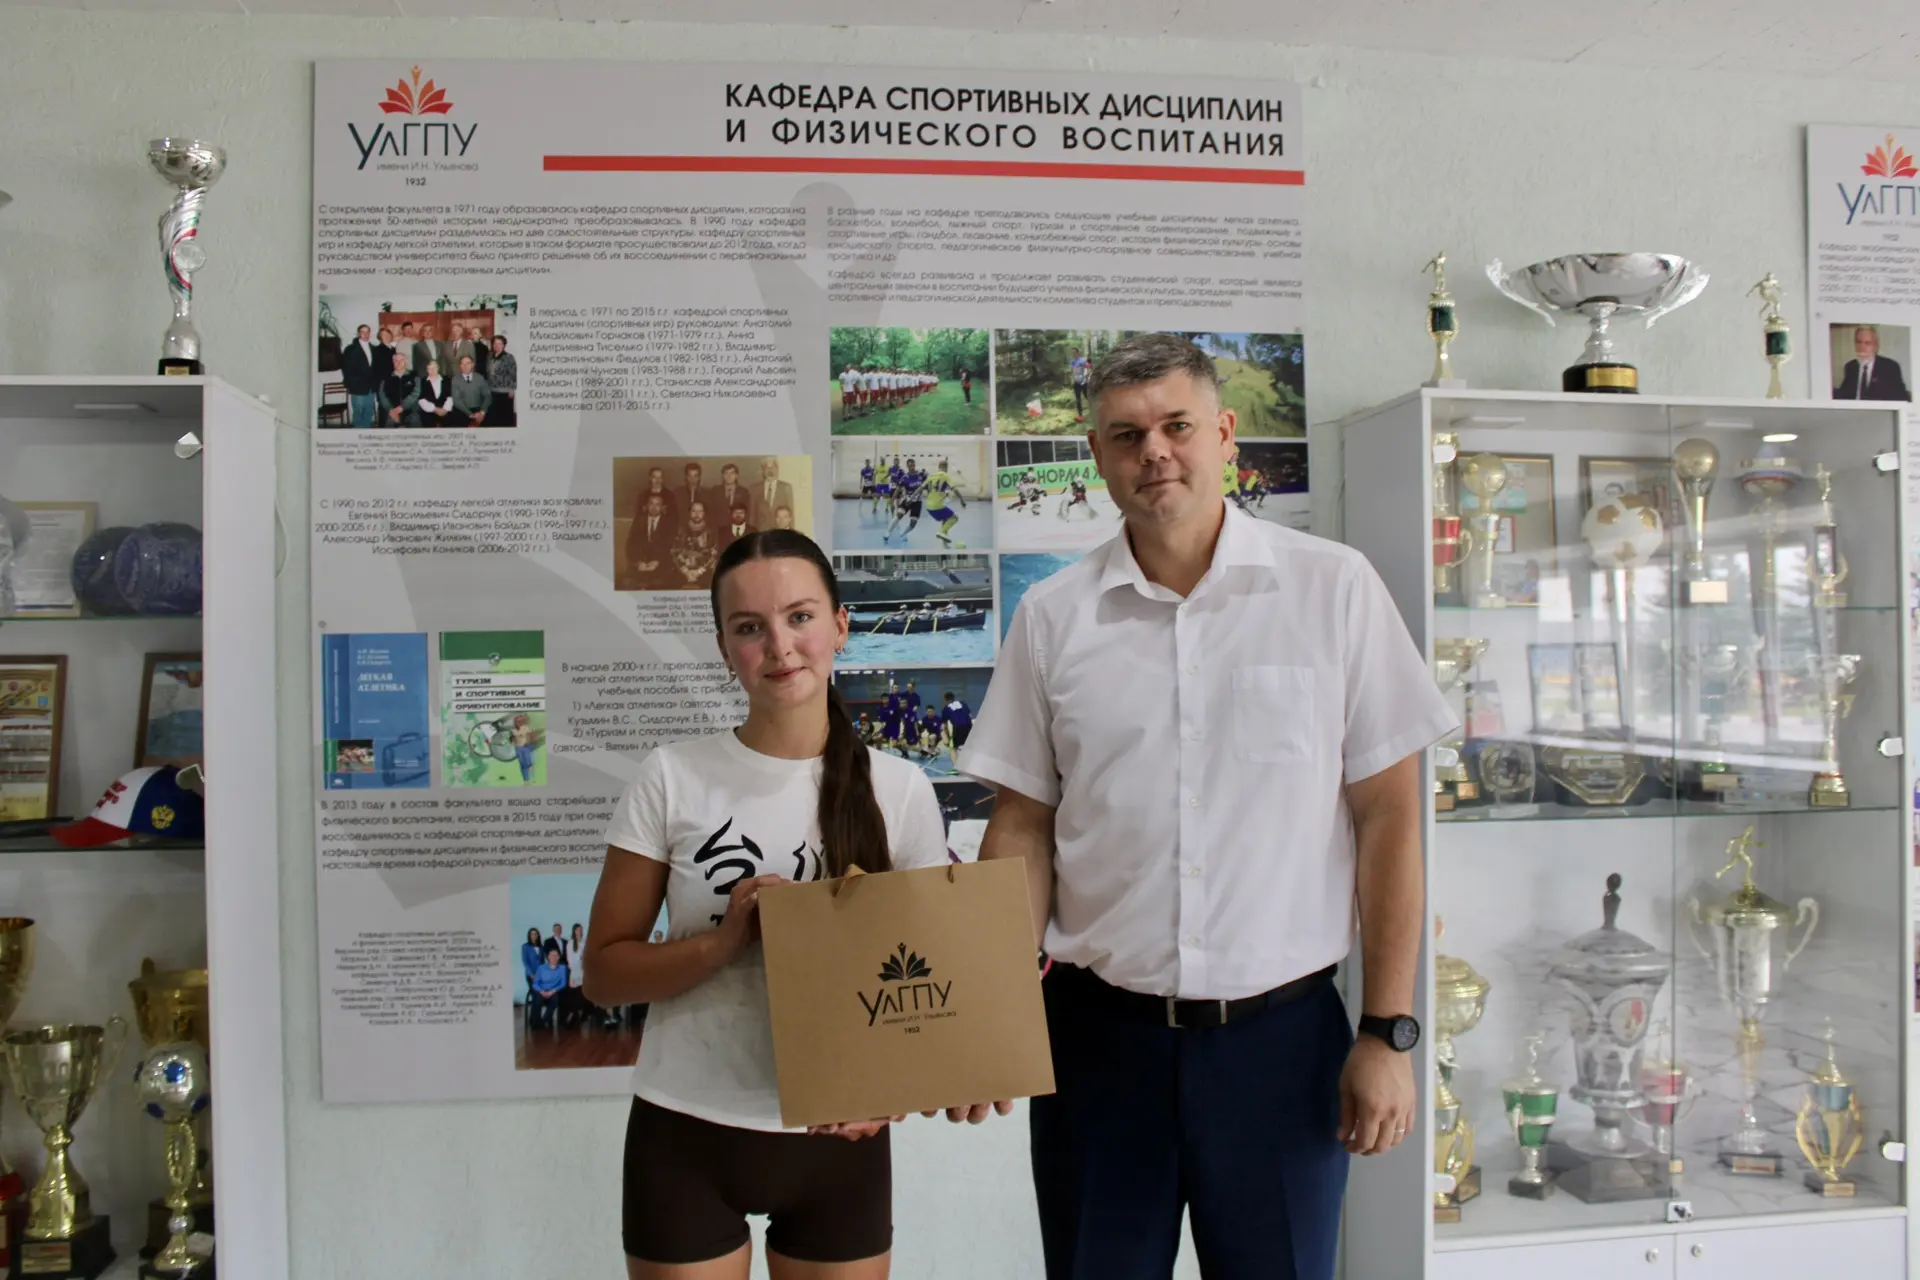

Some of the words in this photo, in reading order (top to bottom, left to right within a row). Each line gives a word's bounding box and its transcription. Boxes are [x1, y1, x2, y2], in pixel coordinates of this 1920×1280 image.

[726, 83, 877, 115] КАФЕДРА
[886, 87, 1090, 117] СПОРТИВНЫХ
[1099, 94, 1283, 124] ДИСЦИПЛИН
[726, 119, 746, 143] И
[771, 118, 1037, 150] ФИЗИЧЕСКОГО
[1062, 127, 1284, 158] ВОСПИТАНИЯ
[376, 162, 409, 171] имени
[433, 161, 479, 172] Ульянова
[405, 178, 427, 187] 1932
[662, 662, 726, 672] преподават
[455, 702, 541, 710] ОРИЕНТИРОВАНИЕ
[729, 714, 749, 724] пер
[585, 812, 613, 822] очер
